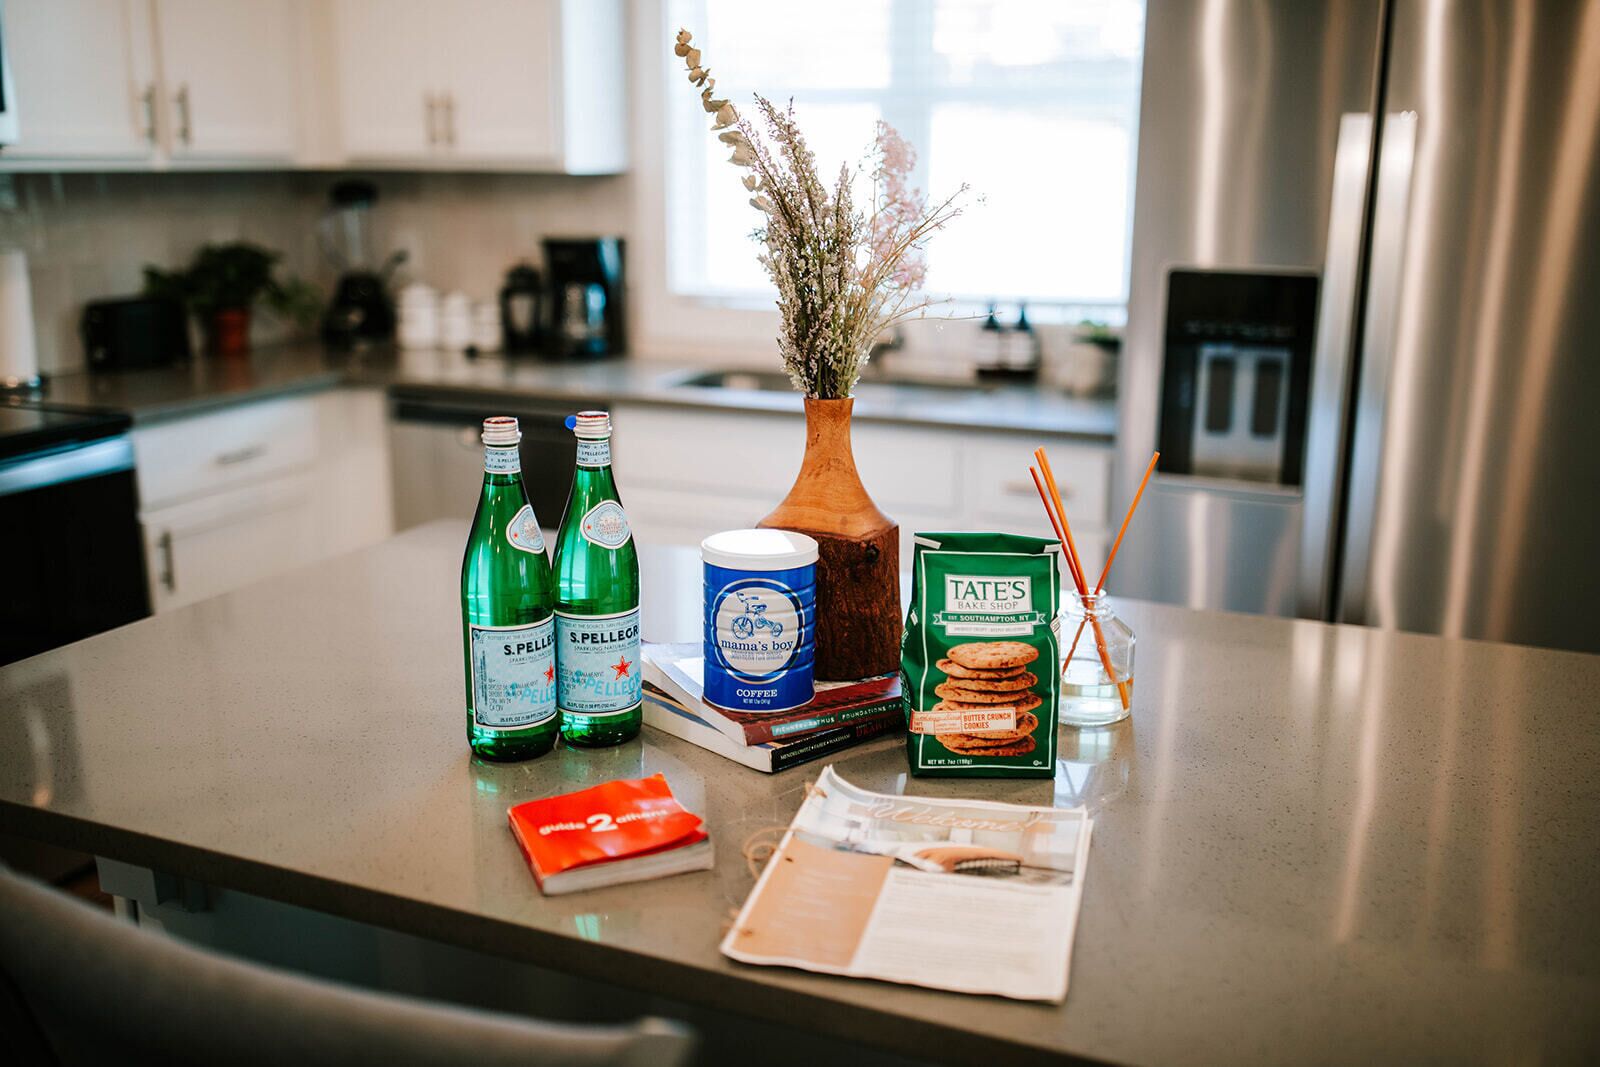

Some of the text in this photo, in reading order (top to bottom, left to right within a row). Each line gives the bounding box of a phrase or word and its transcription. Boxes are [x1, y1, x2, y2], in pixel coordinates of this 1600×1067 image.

[950, 580, 1026, 602] TATE'S
[958, 601, 1018, 610] BAKE SHOP
[721, 640, 794, 651] mama's boy
[736, 688, 778, 698] COFFEE
[842, 706, 887, 720] FOUNDATIONS
[964, 714, 986, 722] BUTTER
[987, 712, 1012, 720] CRUNCH
[964, 722, 990, 730] COOKIES
[539, 822, 586, 836] guide
[586, 813, 618, 832] 2
